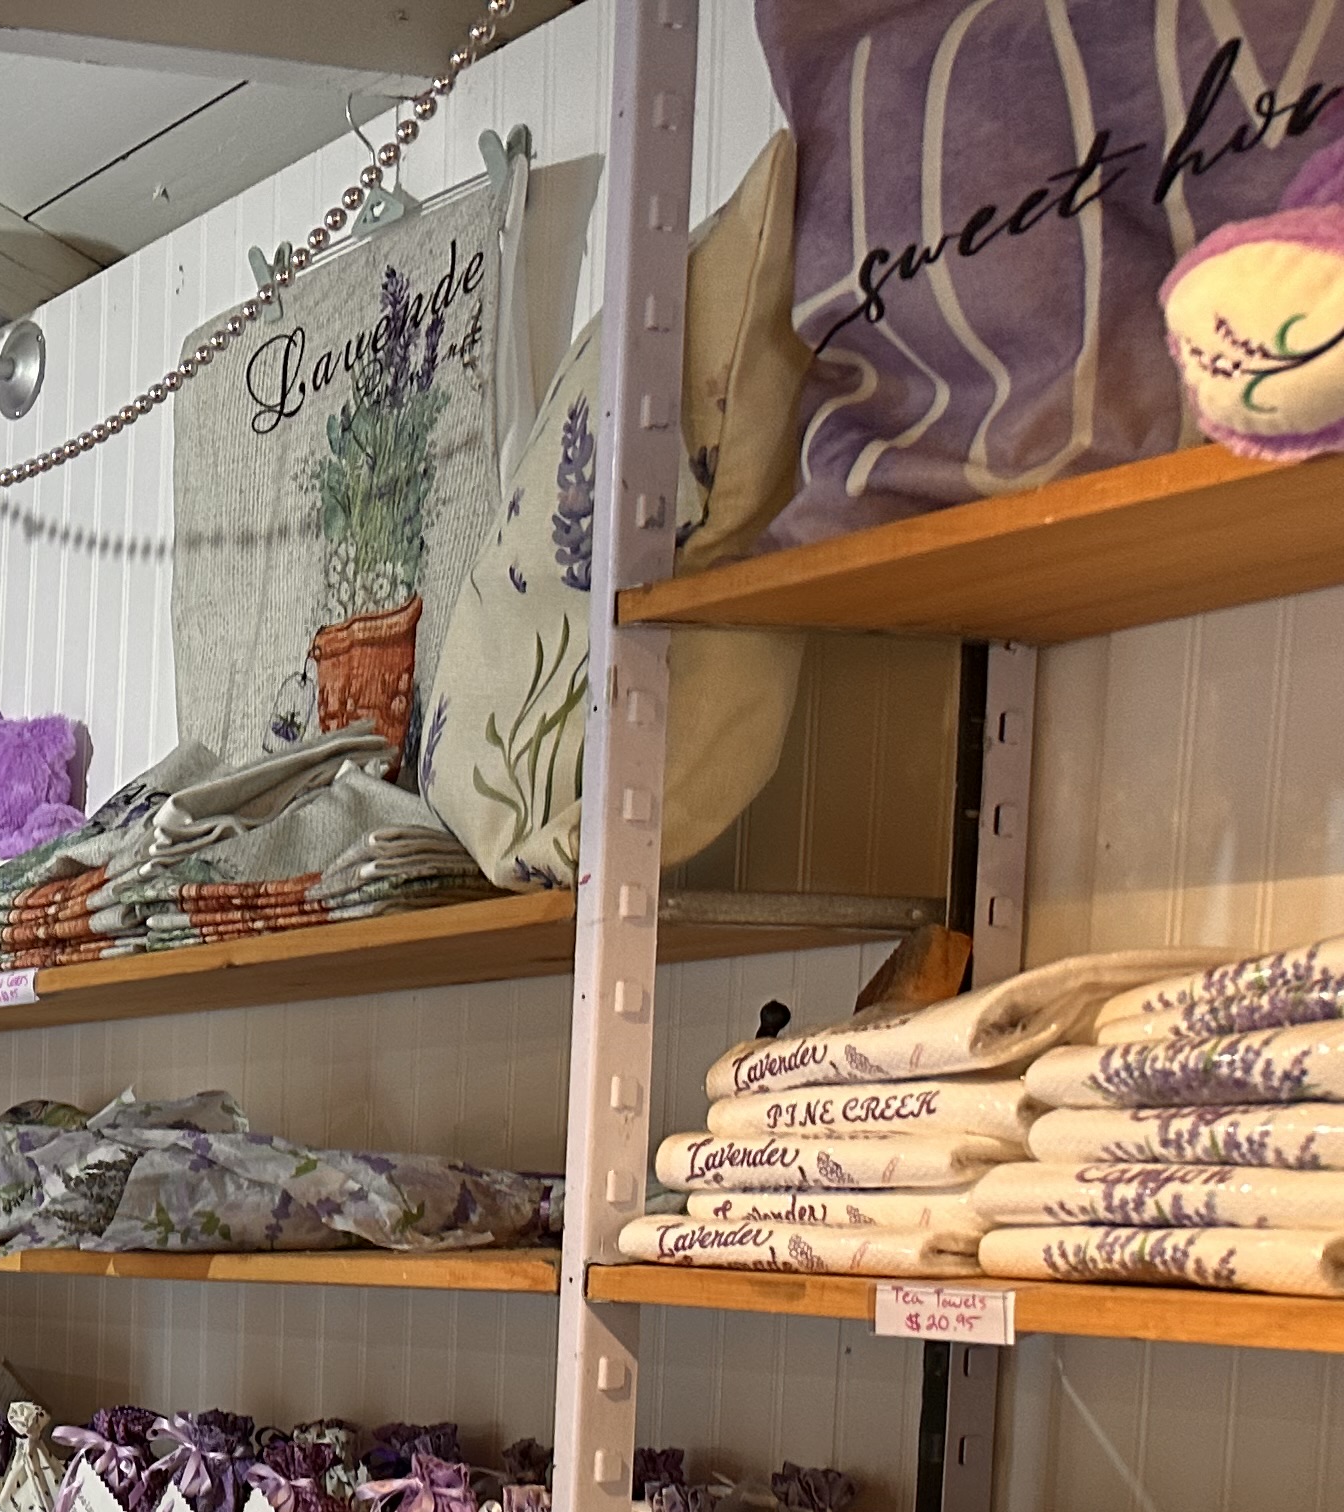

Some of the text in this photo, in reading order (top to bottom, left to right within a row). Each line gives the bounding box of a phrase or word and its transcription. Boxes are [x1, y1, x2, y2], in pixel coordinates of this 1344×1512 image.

[815, 130, 1145, 355] sweet
[732, 1040, 828, 1092] Lavender
[766, 1090, 941, 1129] PINE CREEK
[687, 1134, 801, 1184] Lavender
[656, 1220, 775, 1259] Lavender
[892, 1285, 988, 1311] Tea Towels
